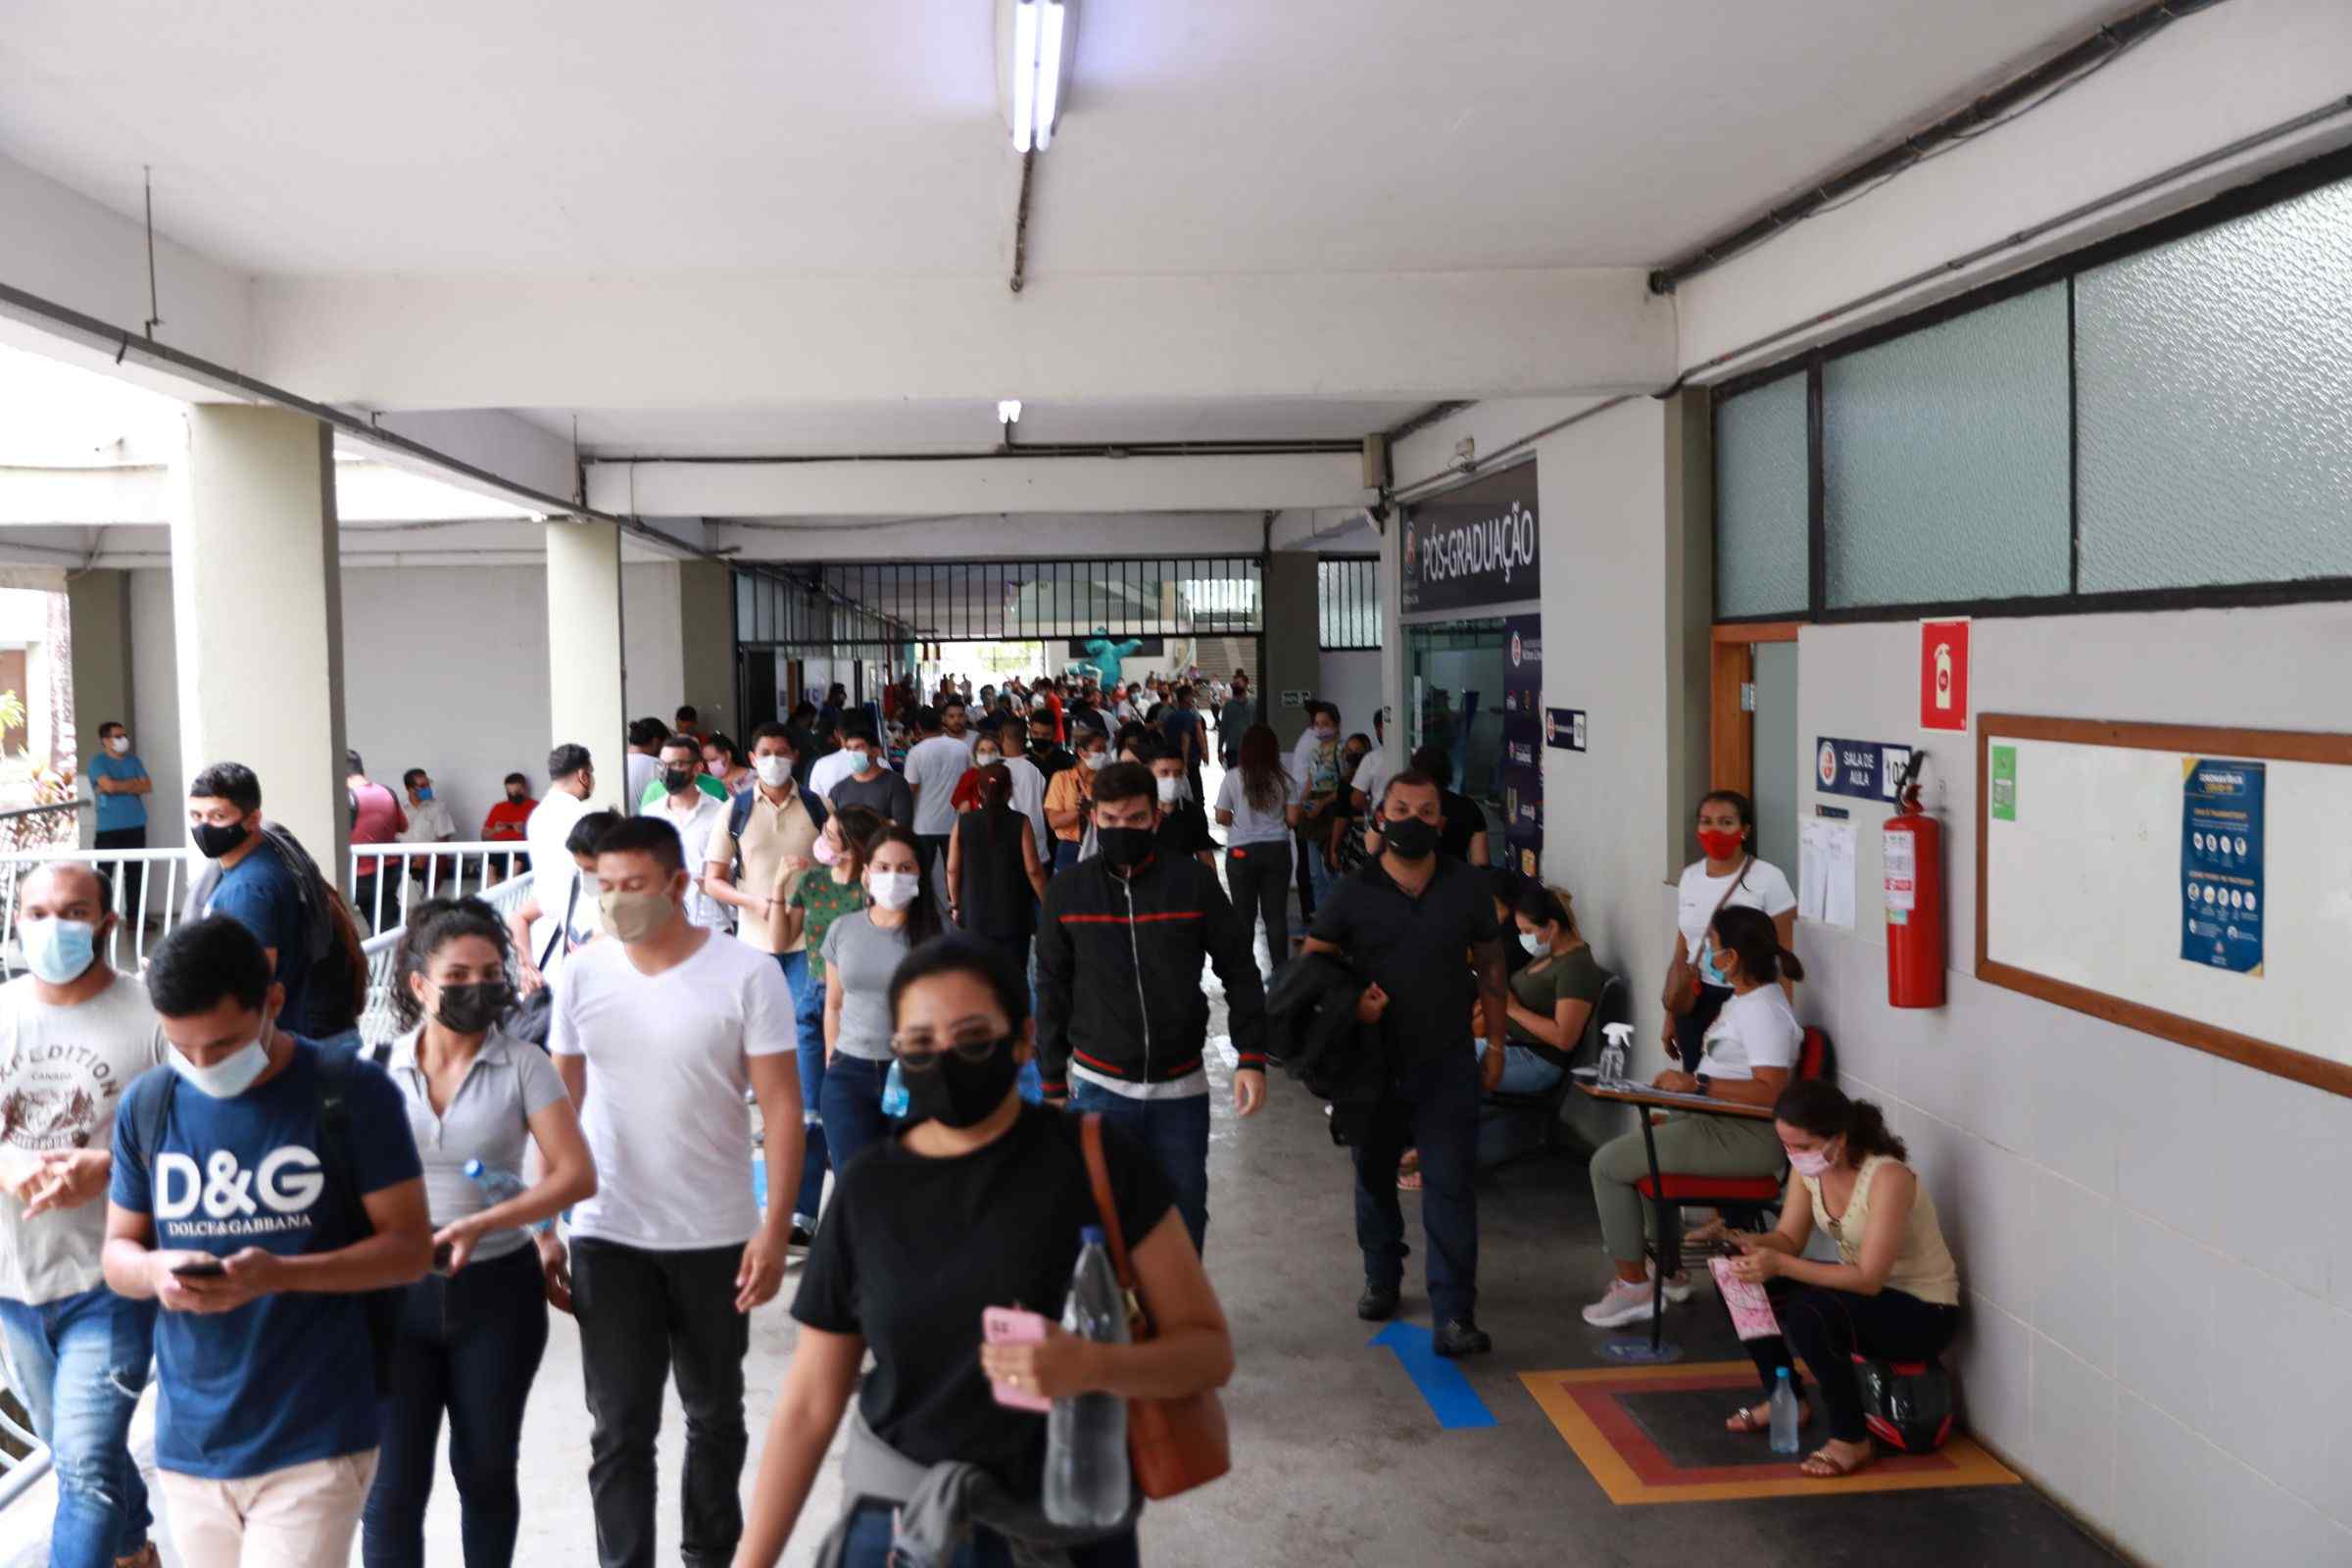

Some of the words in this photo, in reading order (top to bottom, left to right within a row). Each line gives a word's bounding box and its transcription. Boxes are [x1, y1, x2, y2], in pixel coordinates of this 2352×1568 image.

[1423, 500, 1534, 584] PÓS-GRADUAÇÃO
[1842, 751, 1863, 767] SALA
[1863, 753, 1875, 769] DE
[1849, 769, 1870, 787] AULA
[156, 1145, 324, 1220] D&G
[169, 1213, 314, 1238] DOLCE&GABBANA
